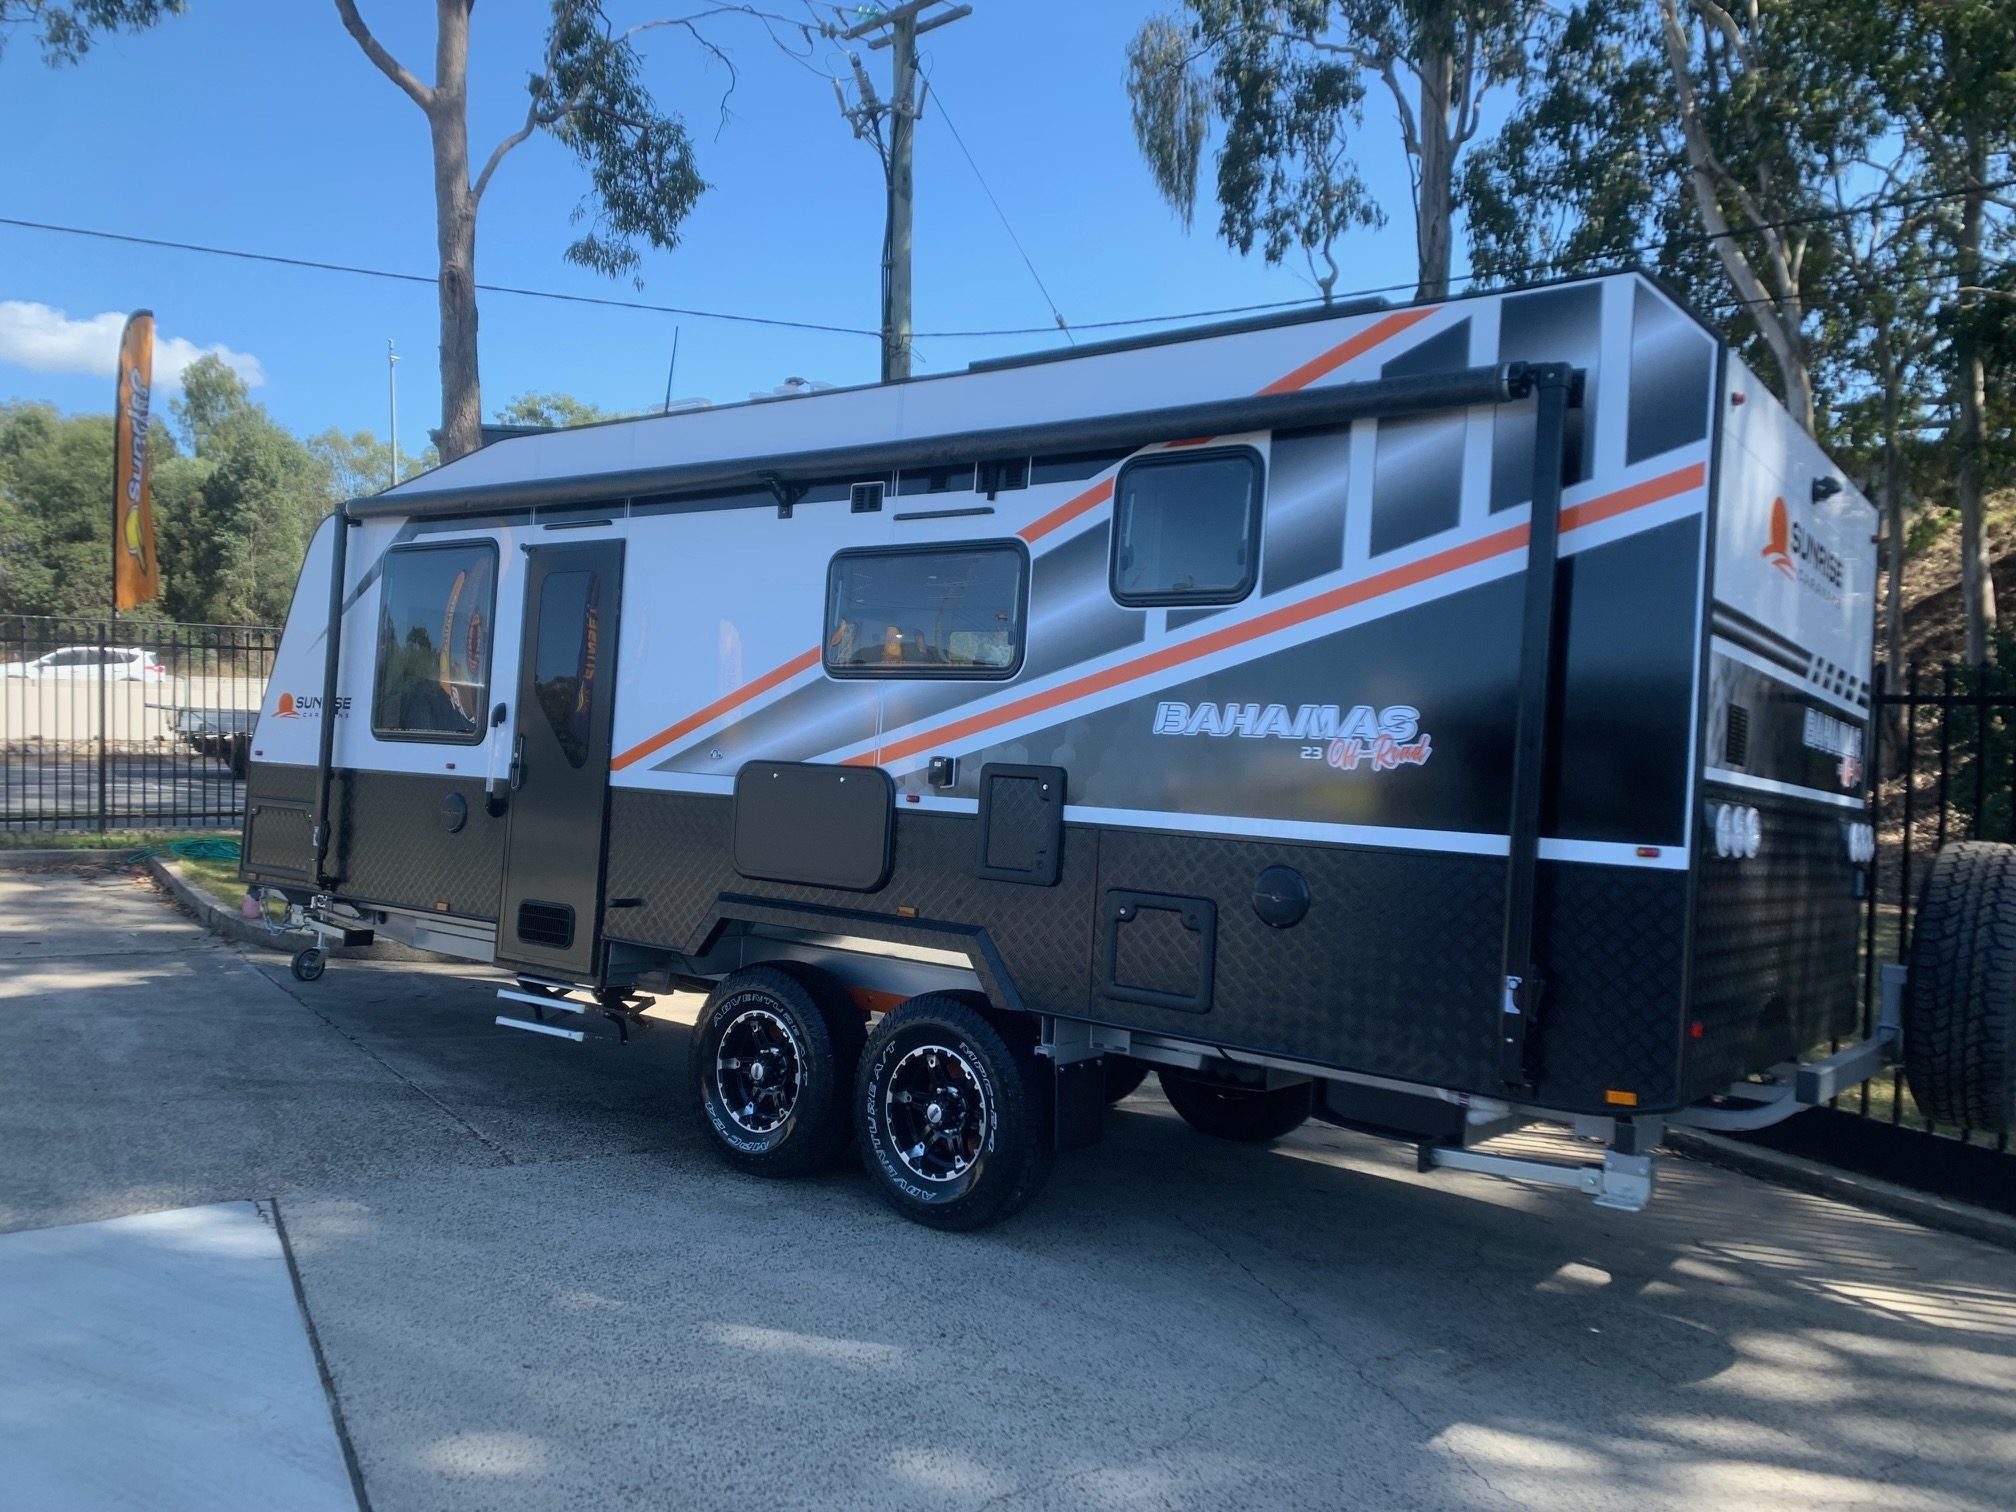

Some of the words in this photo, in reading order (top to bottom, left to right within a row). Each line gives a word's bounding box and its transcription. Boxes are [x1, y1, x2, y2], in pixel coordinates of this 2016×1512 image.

[1792, 521, 1844, 588] SUNRISE
[295, 696, 352, 709] SUNSE
[1152, 701, 1421, 743] BAHAMAS
[1300, 746, 1323, 760] 23
[1326, 733, 1433, 772] Off-Road
[712, 993, 801, 1037] ADVENTURE
[865, 1081, 938, 1202] ADVENTURE
